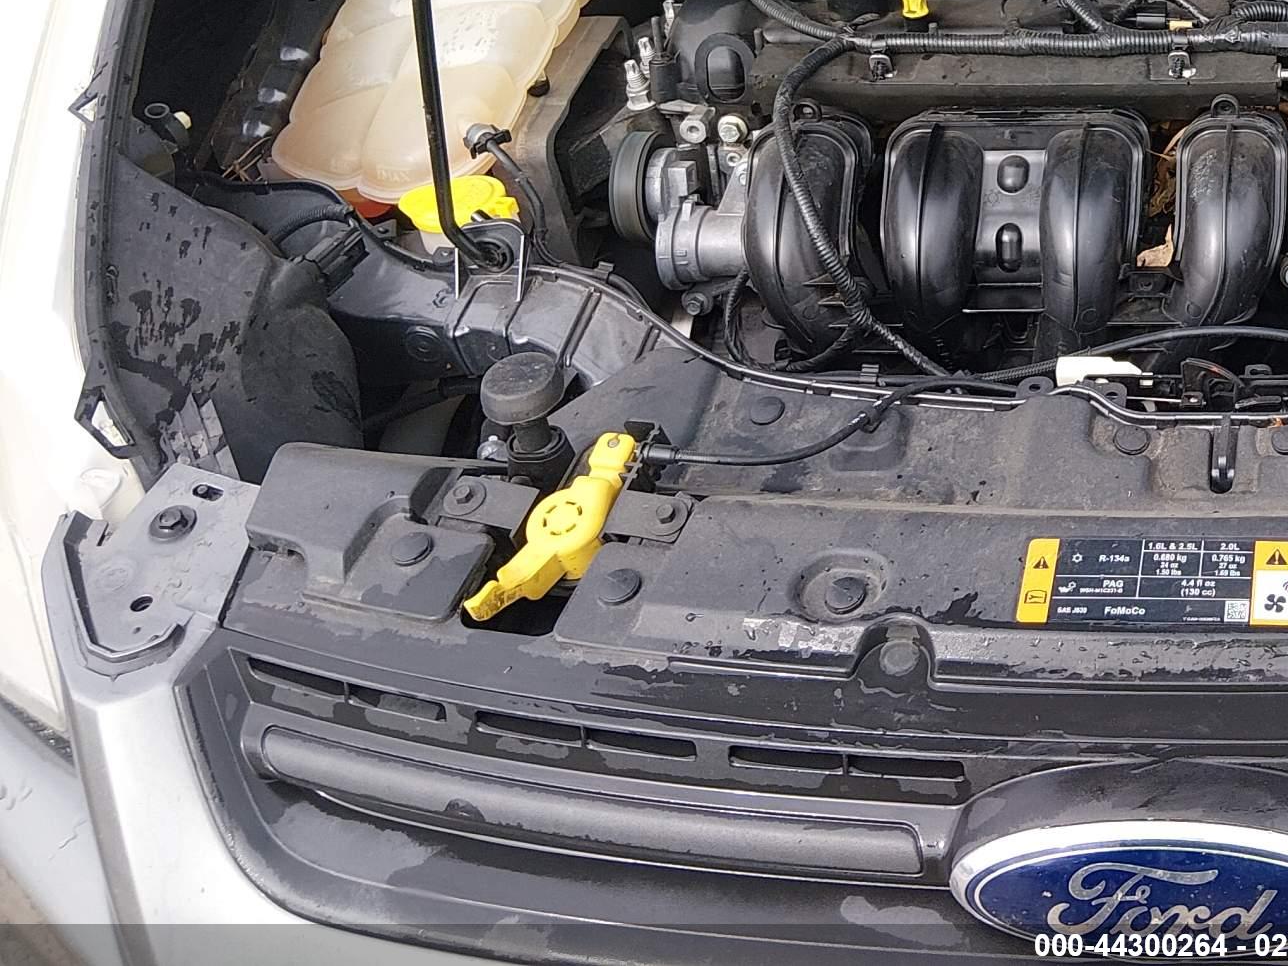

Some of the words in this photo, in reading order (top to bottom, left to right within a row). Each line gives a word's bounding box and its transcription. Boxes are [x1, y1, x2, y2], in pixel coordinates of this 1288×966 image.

[1148, 542, 1168, 550] 1.6L
[1176, 554, 1188, 563] kg
[1211, 554, 1234, 562] 0.765
[1234, 555, 1246, 564] kg
[1103, 579, 1124, 588] PAG
[1181, 579, 1195, 587] 4.4
[1181, 588, 1200, 597] (130
[1201, 588, 1216, 597] cc)
[1104, 606, 1146, 615] FoMoCo
[1046, 861, 1278, 942] Ford
